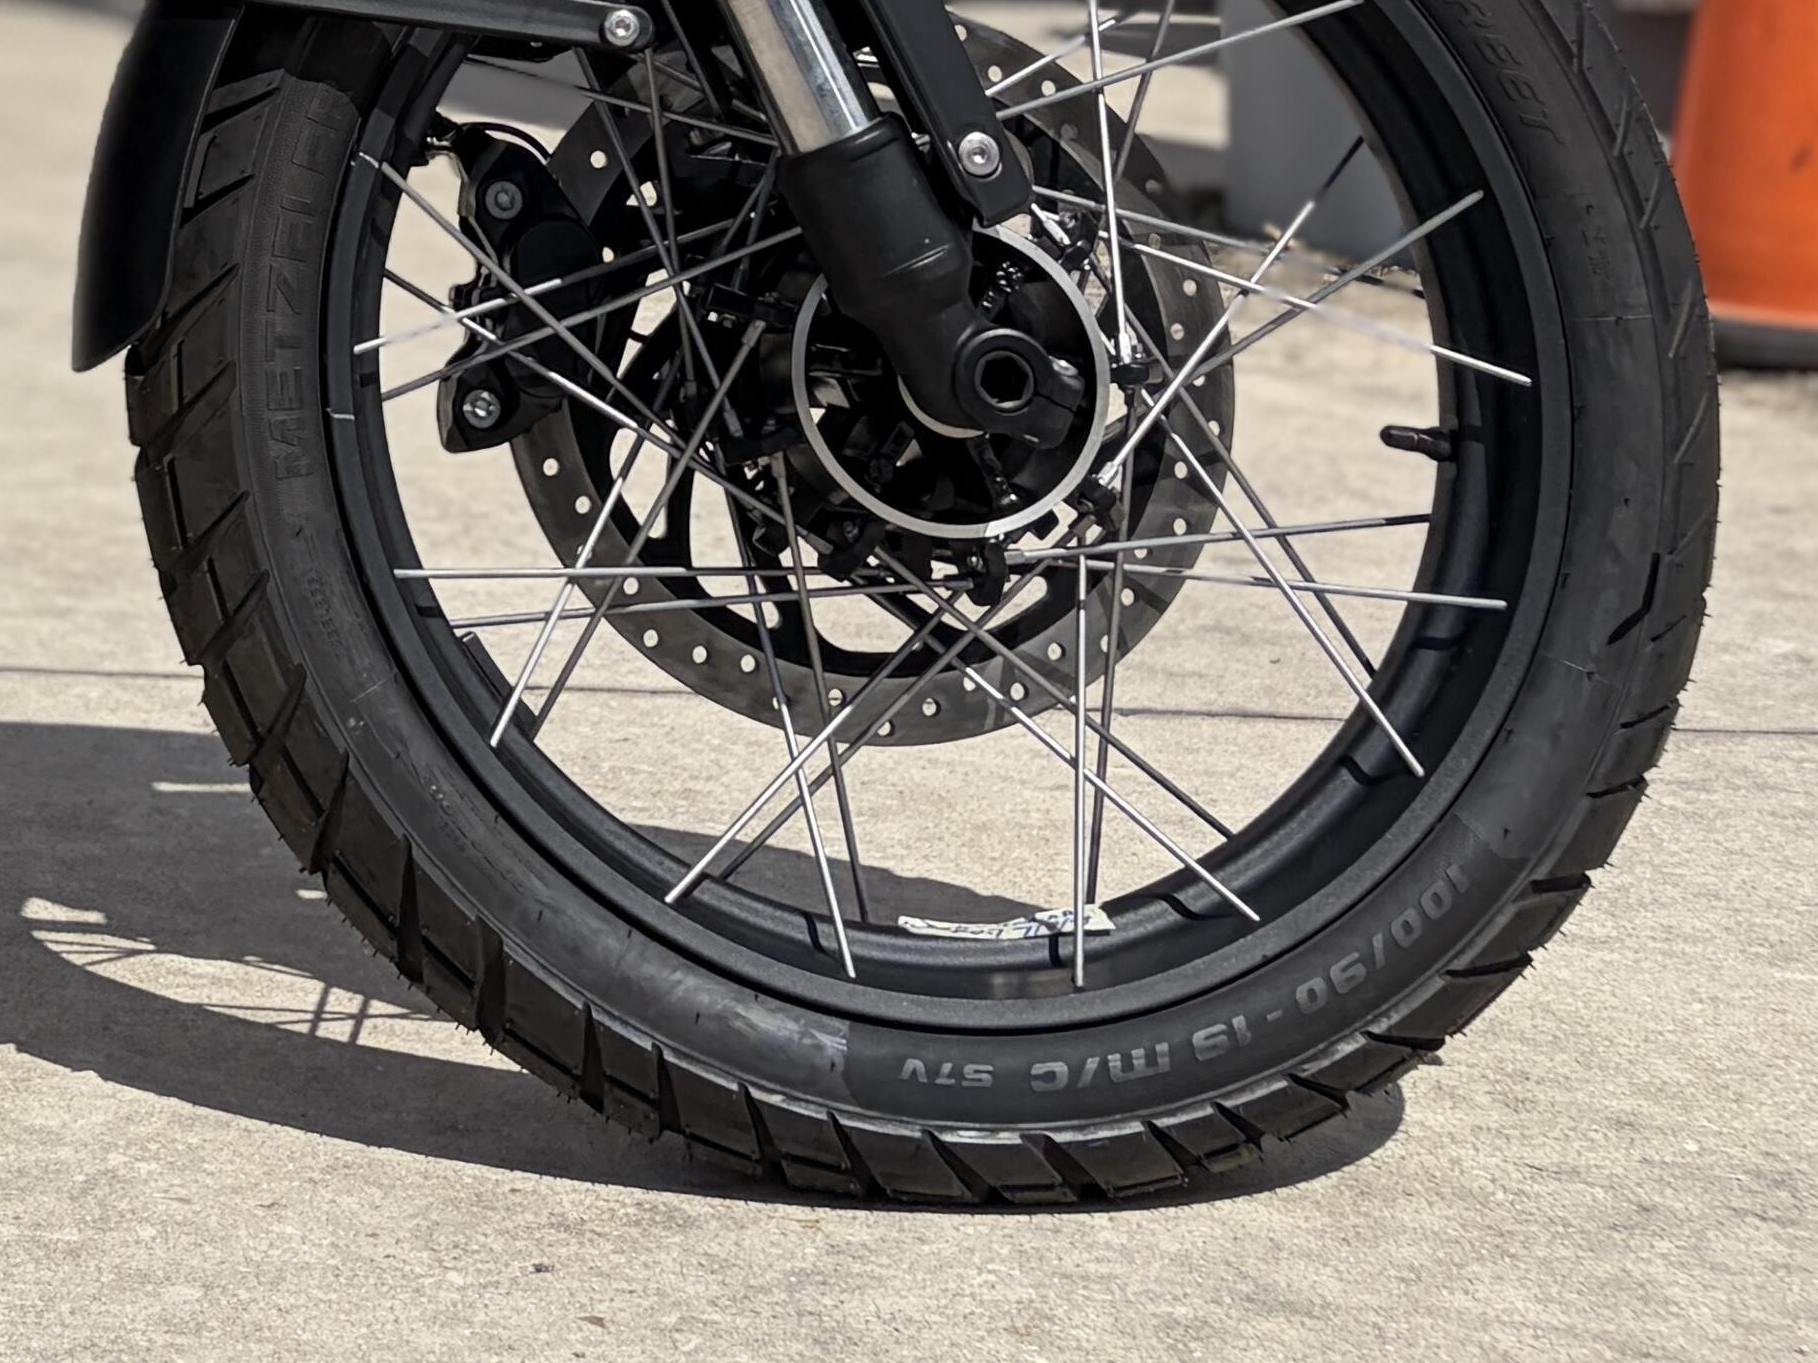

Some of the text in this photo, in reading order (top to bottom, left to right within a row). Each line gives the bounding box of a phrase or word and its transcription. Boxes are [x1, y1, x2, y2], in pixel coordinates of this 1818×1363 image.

[1293, 864, 1471, 1015] 100/90
[1191, 1014, 1253, 1061] 19
[898, 1057, 995, 1089] 57V
[1029, 1041, 1171, 1092] M/C
